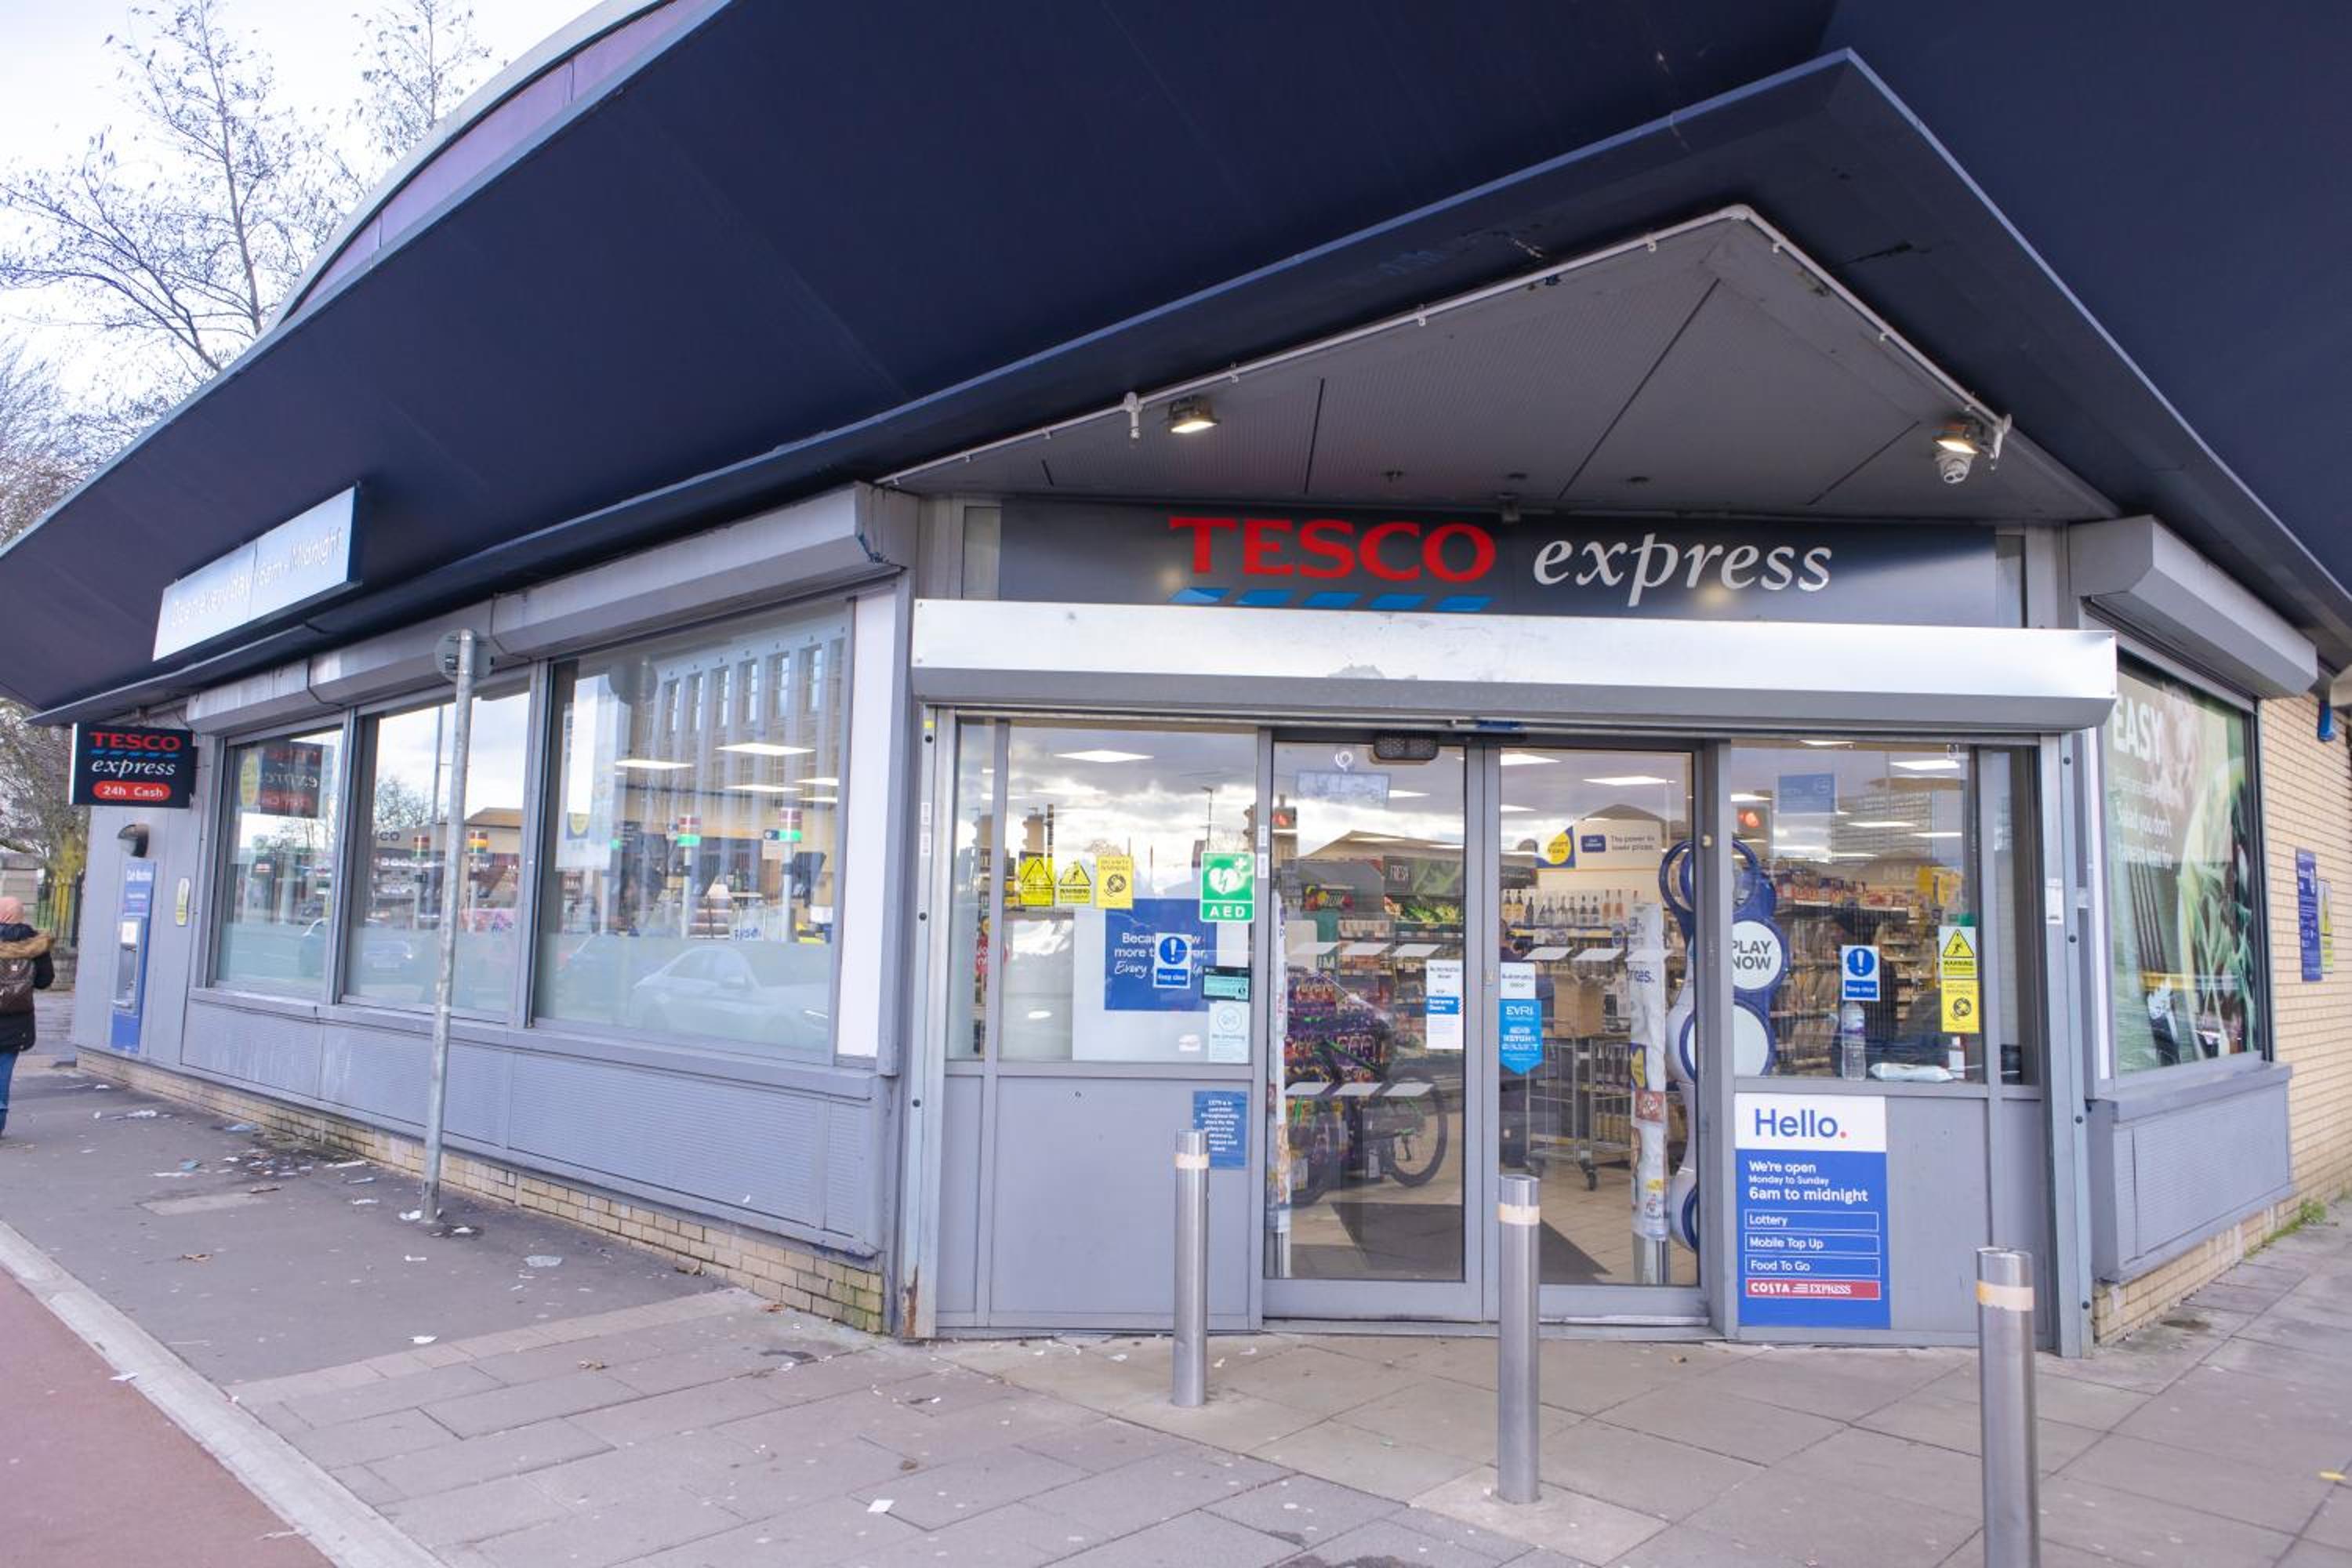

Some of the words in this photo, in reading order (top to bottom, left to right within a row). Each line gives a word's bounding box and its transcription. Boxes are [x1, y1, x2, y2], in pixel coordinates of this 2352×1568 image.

[1168, 516, 1497, 583] TESCO
[1533, 532, 1834, 608] express
[2114, 692, 2164, 766] EASY
[89, 731, 181, 752] TESCO
[92, 759, 176, 779] express
[103, 786, 125, 796] 24h
[134, 786, 163, 797] Cash
[1210, 906, 1245, 917] AED
[1122, 932, 1156, 944] Becau
[1114, 949, 1146, 957] more
[1732, 941, 1772, 954] PLAY
[1114, 960, 1147, 978] Every
[1733, 956, 1771, 971] NOW
[1506, 1006, 1534, 1015] EVRI
[1755, 1109, 1847, 1138] Hello.
[1748, 1160, 1782, 1172] We're
[1785, 1163, 1817, 1174] open
[1748, 1175, 1783, 1185] Monday
[1798, 1176, 1829, 1185] Sunday
[1749, 1186, 1780, 1200] 6am
[1785, 1188, 1800, 1200] to
[1804, 1188, 1868, 1204] midnight
[1749, 1214, 1788, 1226] Lottery
[1749, 1238, 1784, 1248] Mobile
[1788, 1239, 1806, 1250] Top
[1809, 1239, 1824, 1250] Up
[1751, 1261, 1777, 1270] Food
[1781, 1261, 1792, 1271] To
[1795, 1261, 1810, 1271] Go
[1751, 1283, 1790, 1294] COSTA
[1809, 1283, 1851, 1294] EXPRESS
